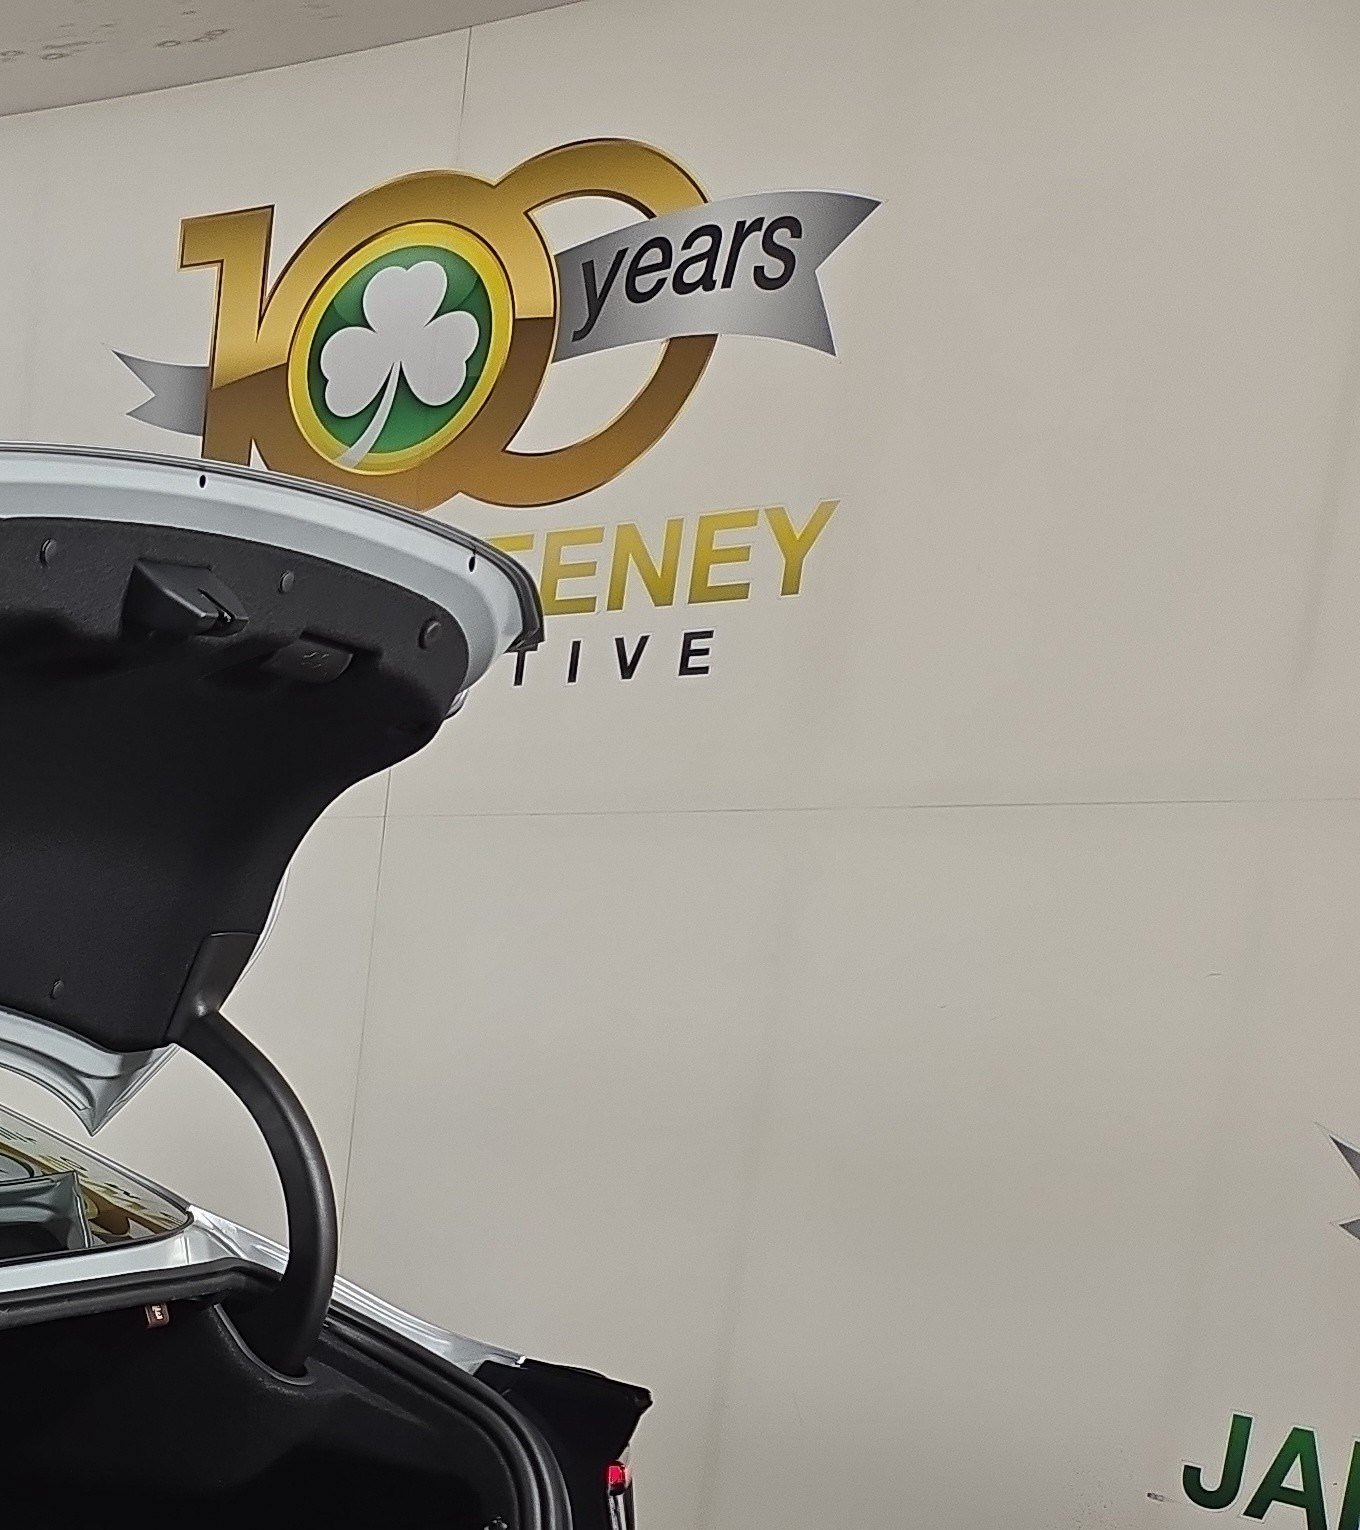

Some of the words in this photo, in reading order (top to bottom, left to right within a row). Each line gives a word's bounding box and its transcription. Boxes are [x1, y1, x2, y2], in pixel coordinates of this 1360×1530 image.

[571, 214, 802, 340] years
[483, 500, 841, 617] ENEY
[508, 629, 714, 687] TIVE
